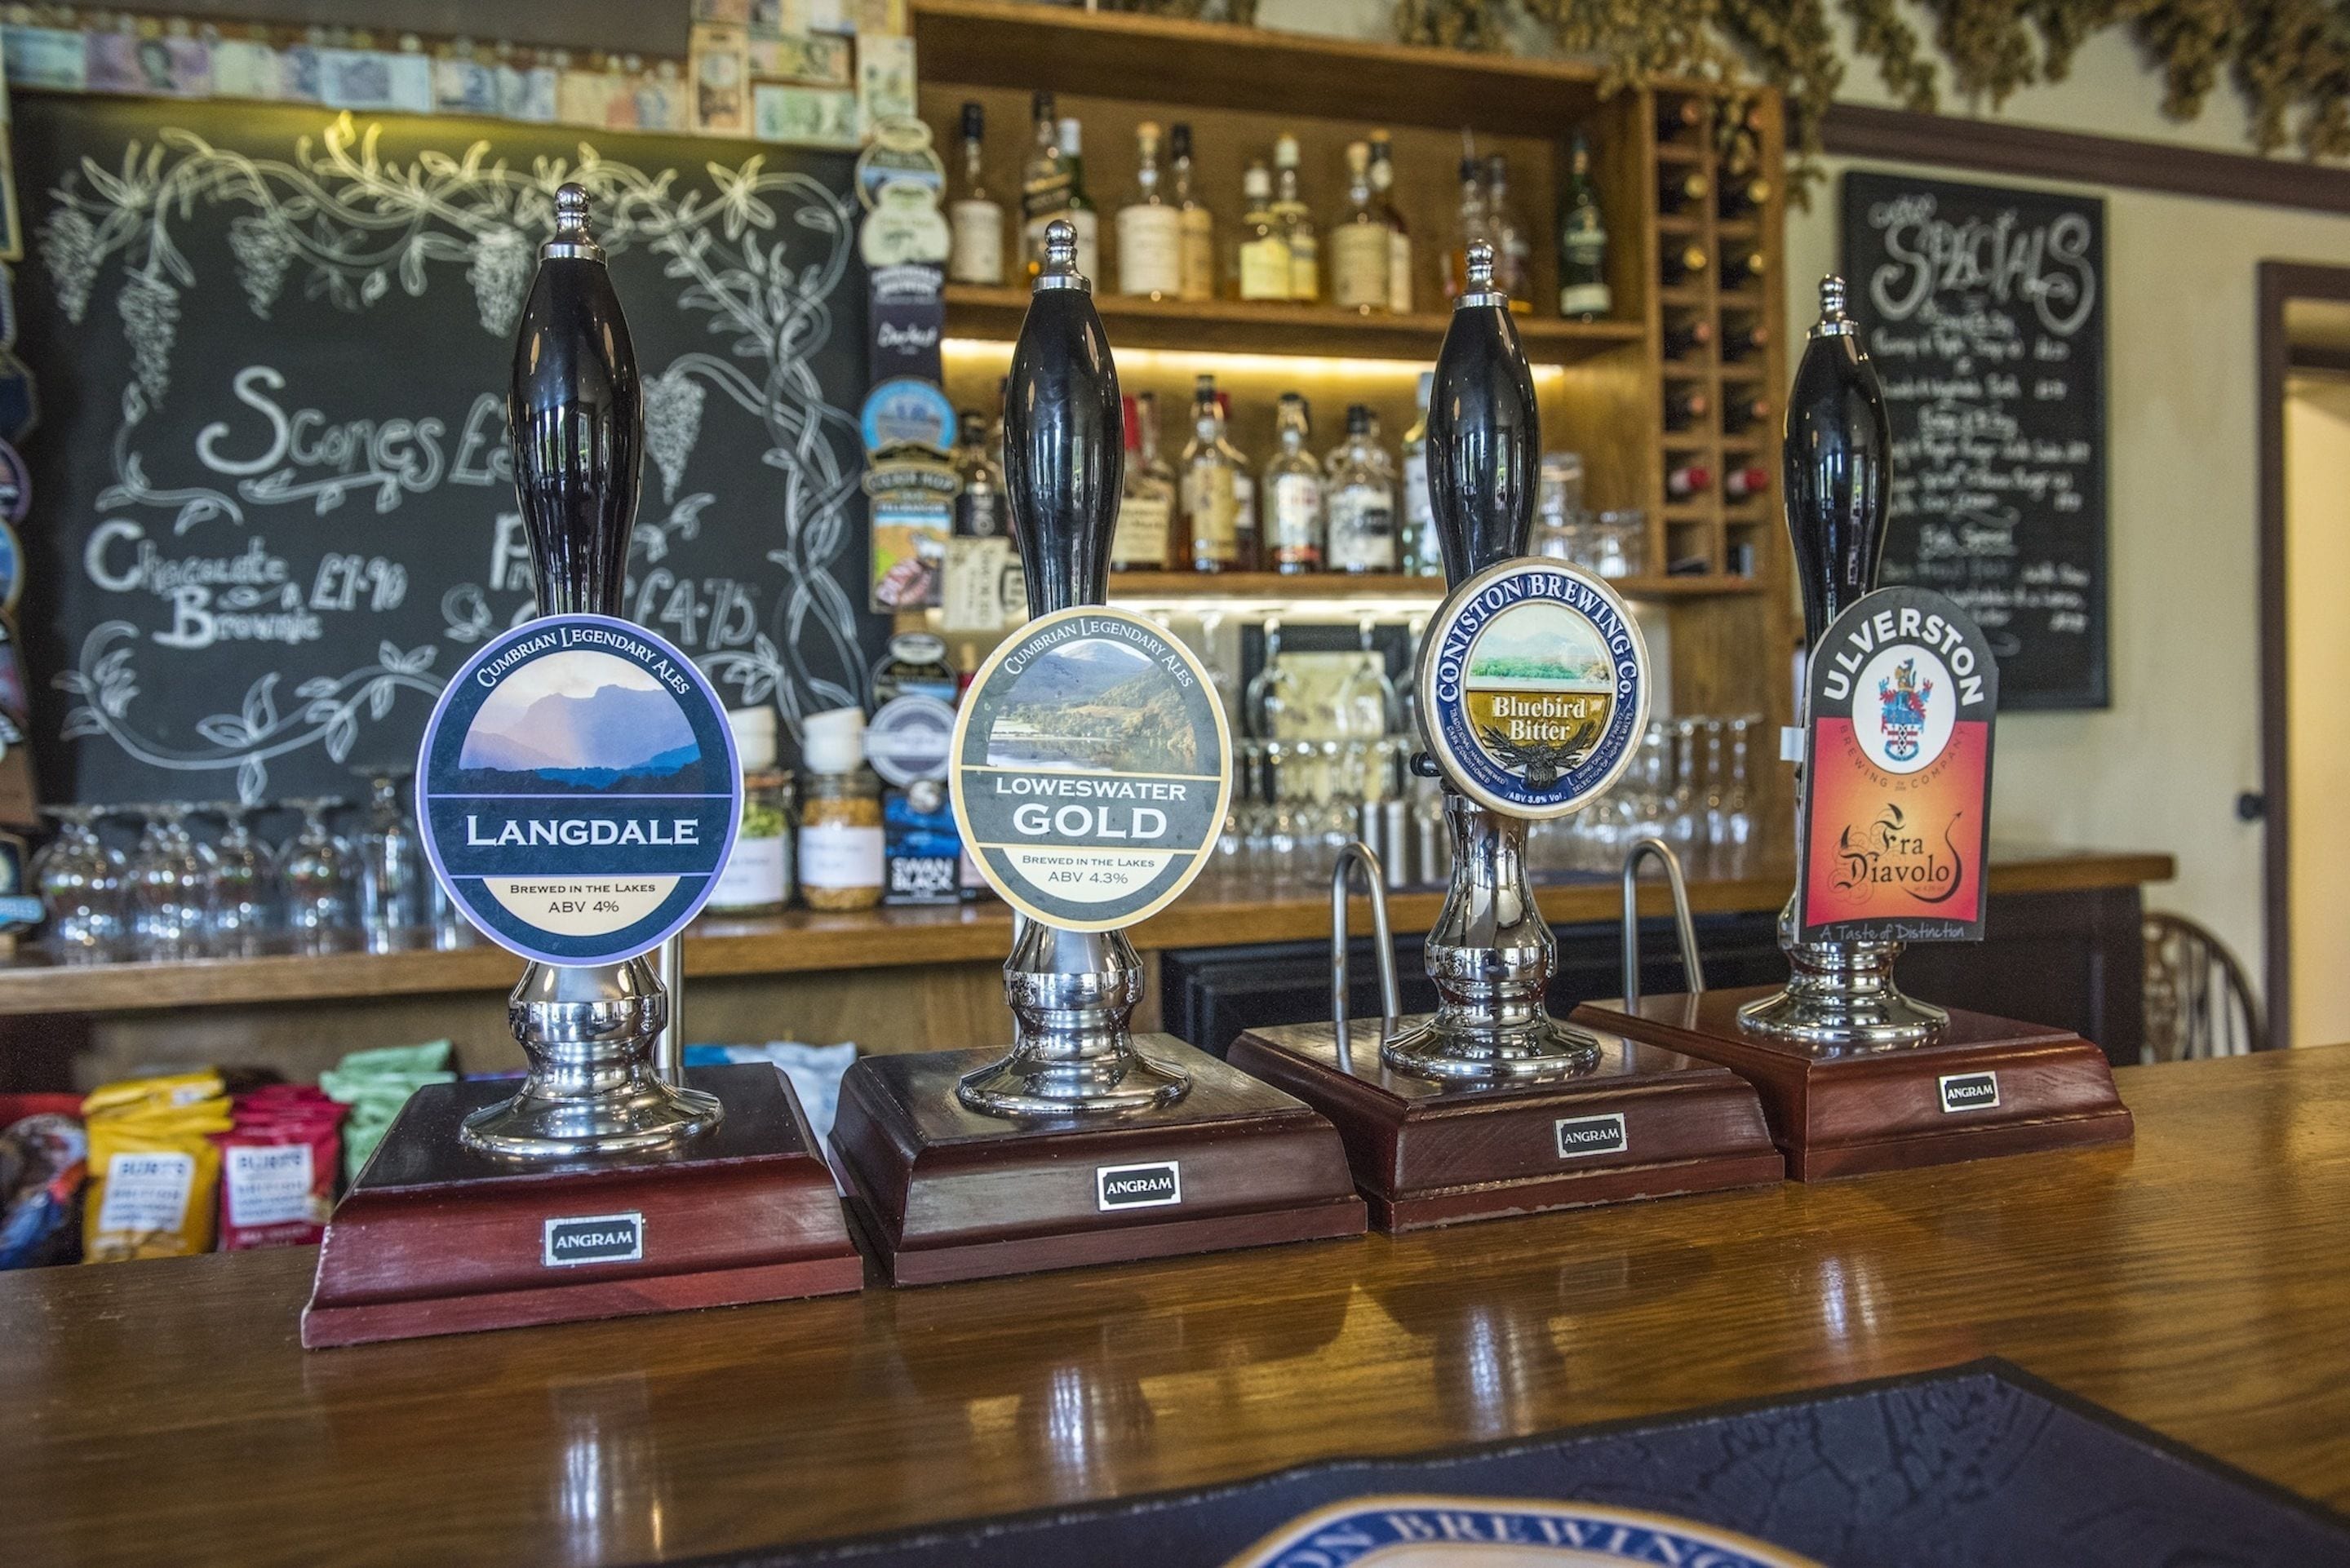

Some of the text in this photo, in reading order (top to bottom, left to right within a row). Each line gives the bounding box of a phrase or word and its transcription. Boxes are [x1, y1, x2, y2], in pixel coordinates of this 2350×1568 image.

[1439, 576, 1522, 702] CONISTON
[1528, 574, 1631, 655] BREWING
[477, 627, 690, 695] CUMBRIAN LEGENDARY ALES
[1004, 618, 1194, 687] CUMBRIAN LEGENDARY ALES
[1824, 608, 1984, 706] ULVERSTON
[1492, 695, 1588, 719] Bluebird
[1509, 720, 1571, 741] Bitter
[1839, 724, 1887, 788] BREWING
[1911, 727, 1964, 788] COMPANY
[995, 777, 1186, 801] LOWESWATER
[466, 815, 699, 846] LANGDALE
[1013, 803, 1168, 839] GOLD
[1022, 855, 1155, 867] BREWED IN THE LAKES
[1834, 848, 1950, 889] Diavolo
[510, 883, 655, 894] BREWED IN THE LAKES
[1048, 871, 1128, 884] ABV 4.3%
[548, 901, 619, 913] ABV 4%
[1820, 922, 1965, 941] A Taste of Distinction
[1948, 1084, 1993, 1100] ANGRAM
[1565, 1128, 1620, 1145] ANGRAM
[1106, 1177, 1173, 1194] ANGRAM
[555, 1231, 633, 1249] ANGRAM
